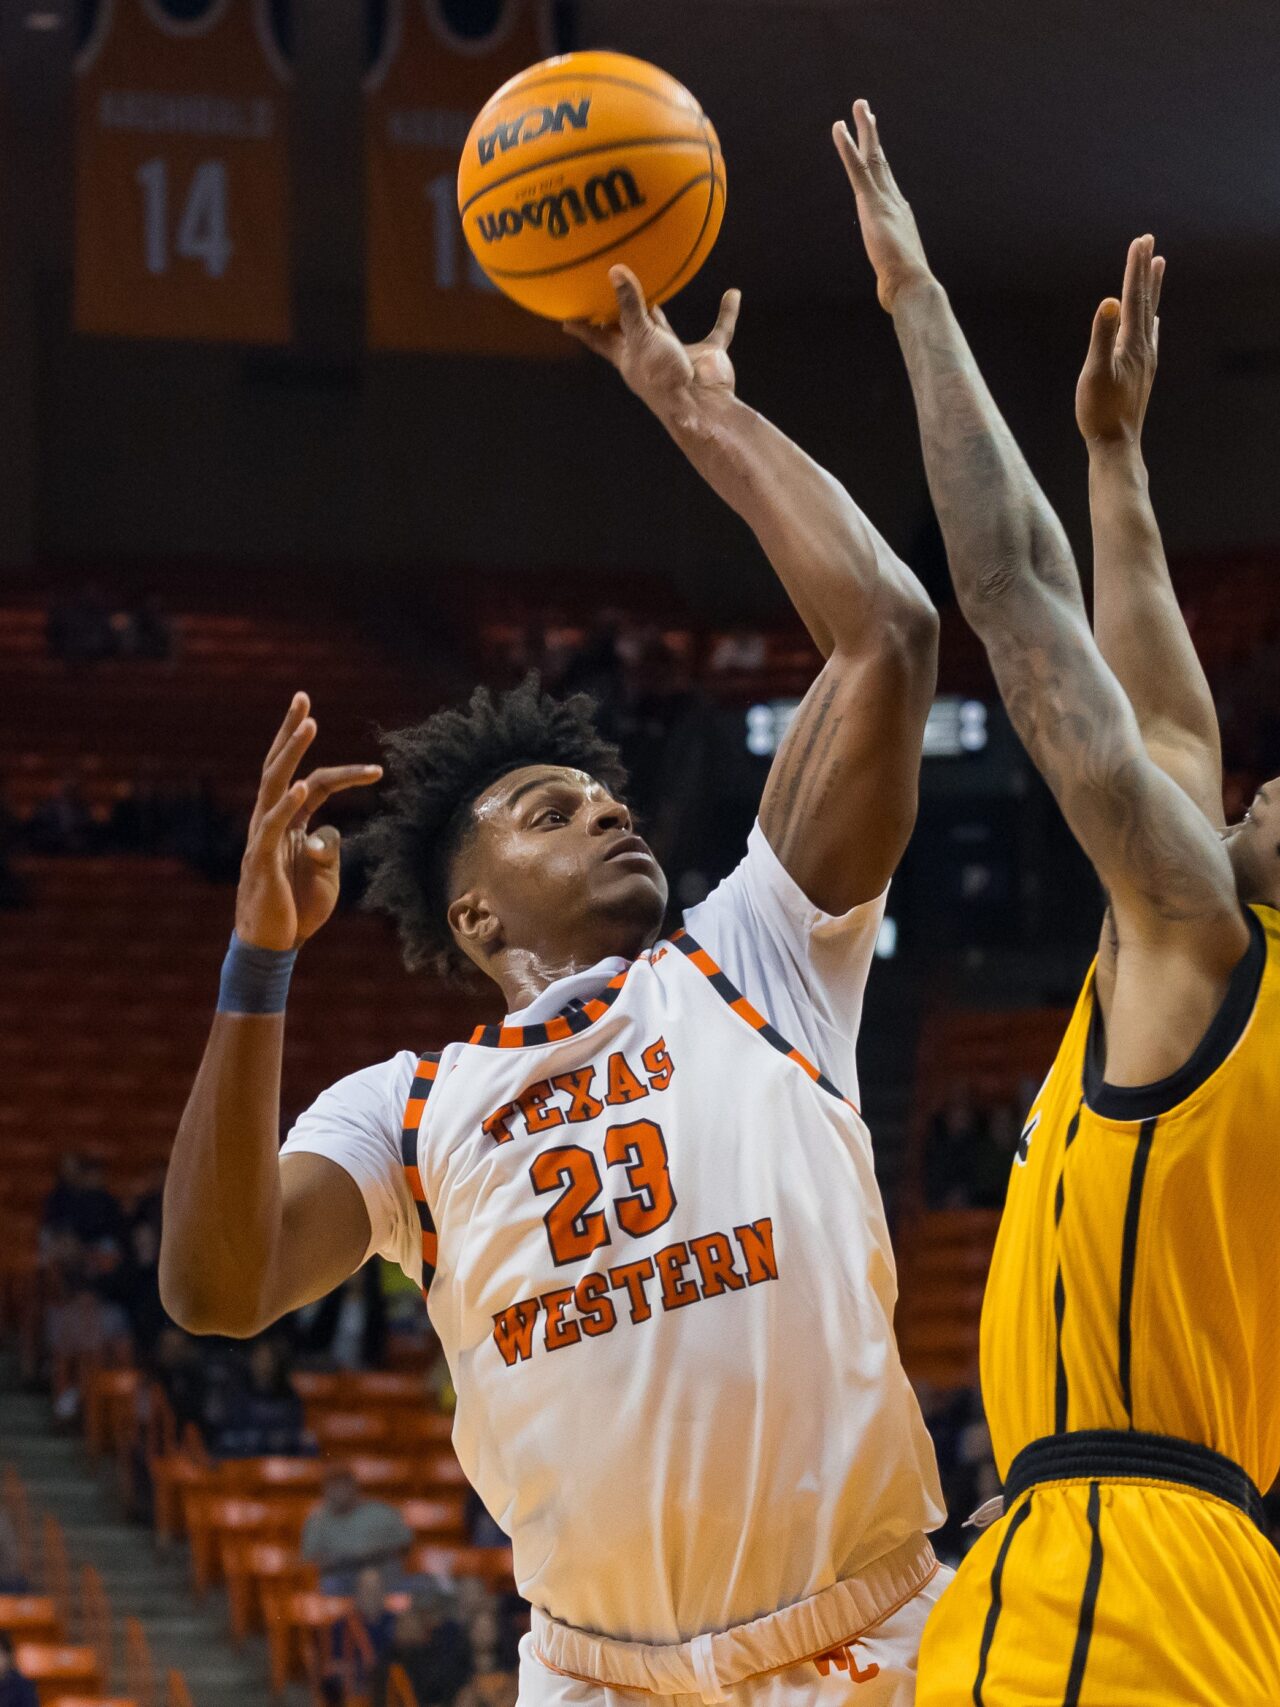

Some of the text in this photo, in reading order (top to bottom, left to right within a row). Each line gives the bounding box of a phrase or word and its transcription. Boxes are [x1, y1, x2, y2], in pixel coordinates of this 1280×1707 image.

[478, 98, 591, 166] NCAA
[136, 158, 233, 279] 14
[477, 166, 647, 244] Wilson
[481, 1036, 676, 1146] TEXAS
[528, 1118, 678, 1268] 23
[492, 1218, 779, 1367] WESTERN
